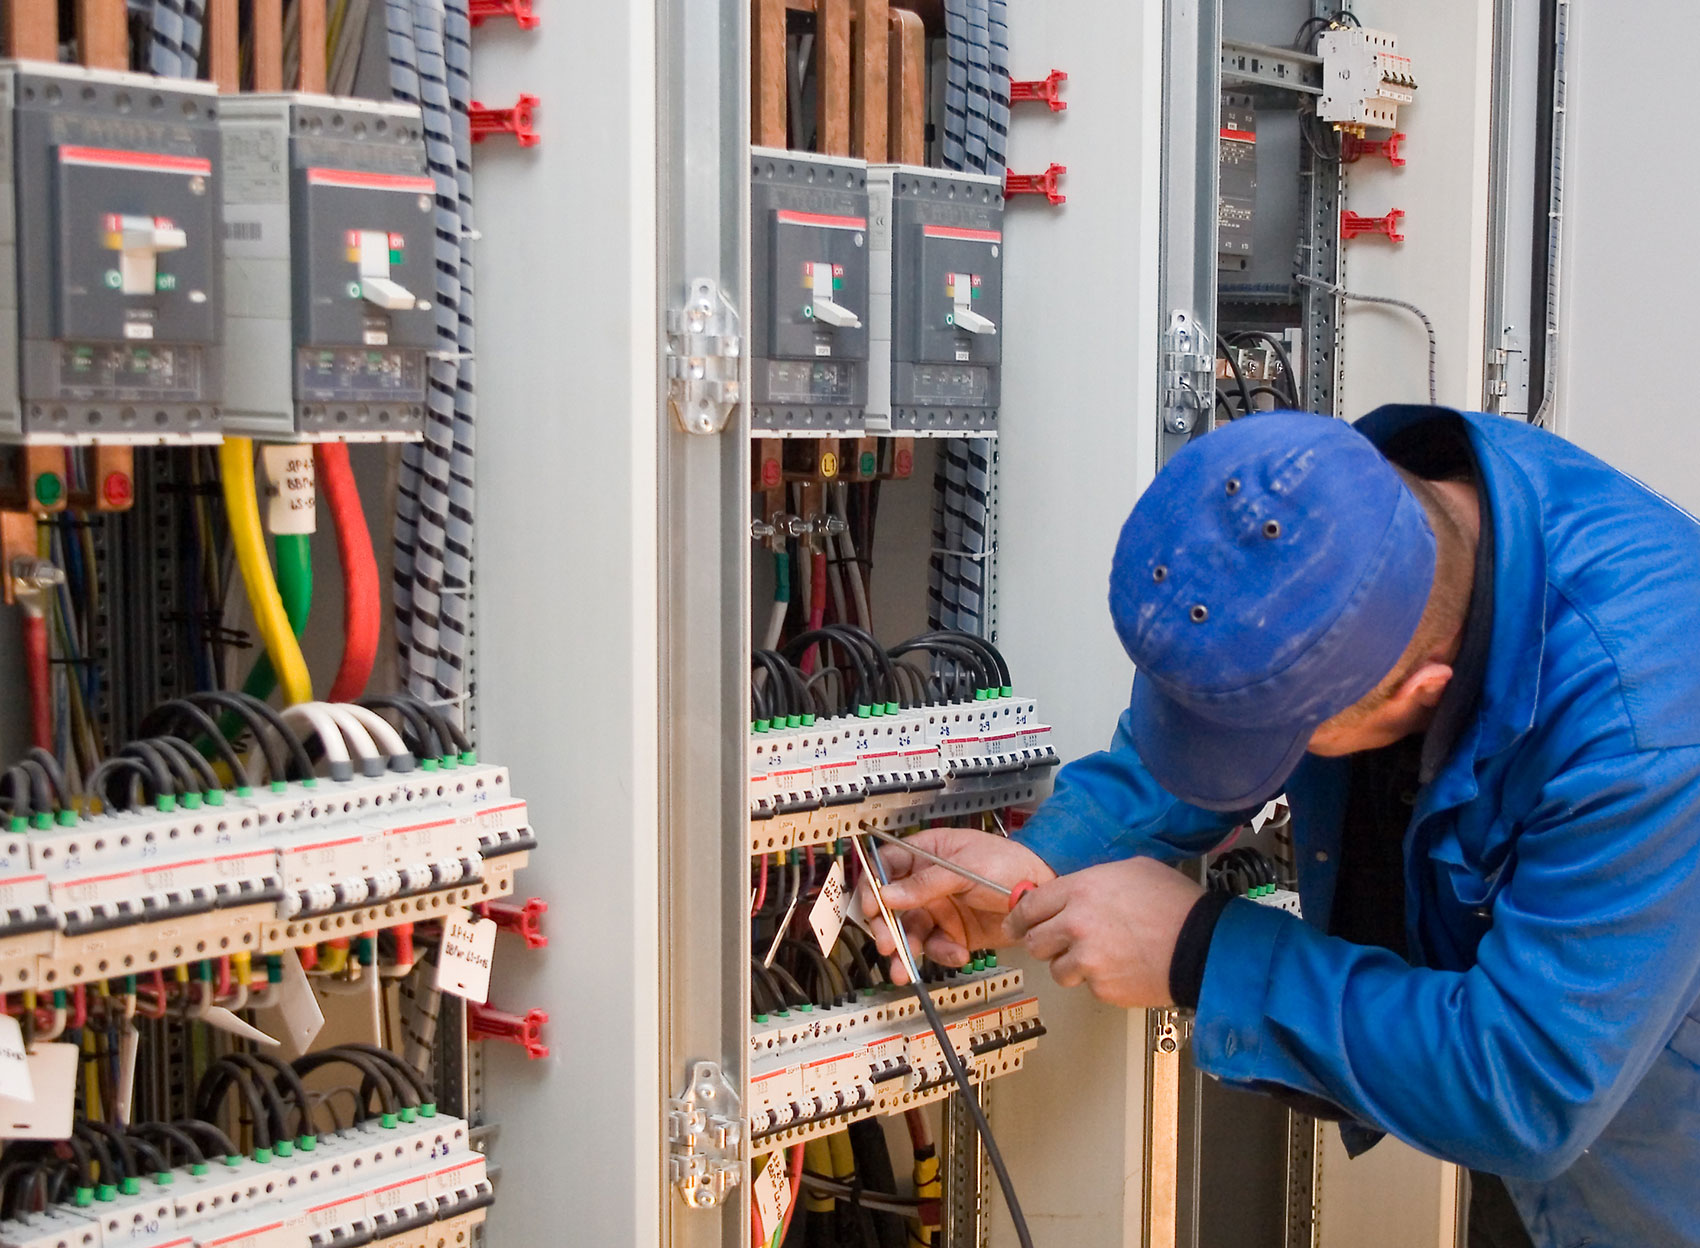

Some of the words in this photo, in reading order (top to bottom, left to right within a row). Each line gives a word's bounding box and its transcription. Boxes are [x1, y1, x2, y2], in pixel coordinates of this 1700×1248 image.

[834, 266, 844, 276] on
[160, 274, 176, 289] off
[823, 458, 836, 473] L1
[856, 739, 868, 750] 2-5
[898, 735, 911, 746] 2-6
[768, 755, 782, 766] 2-3
